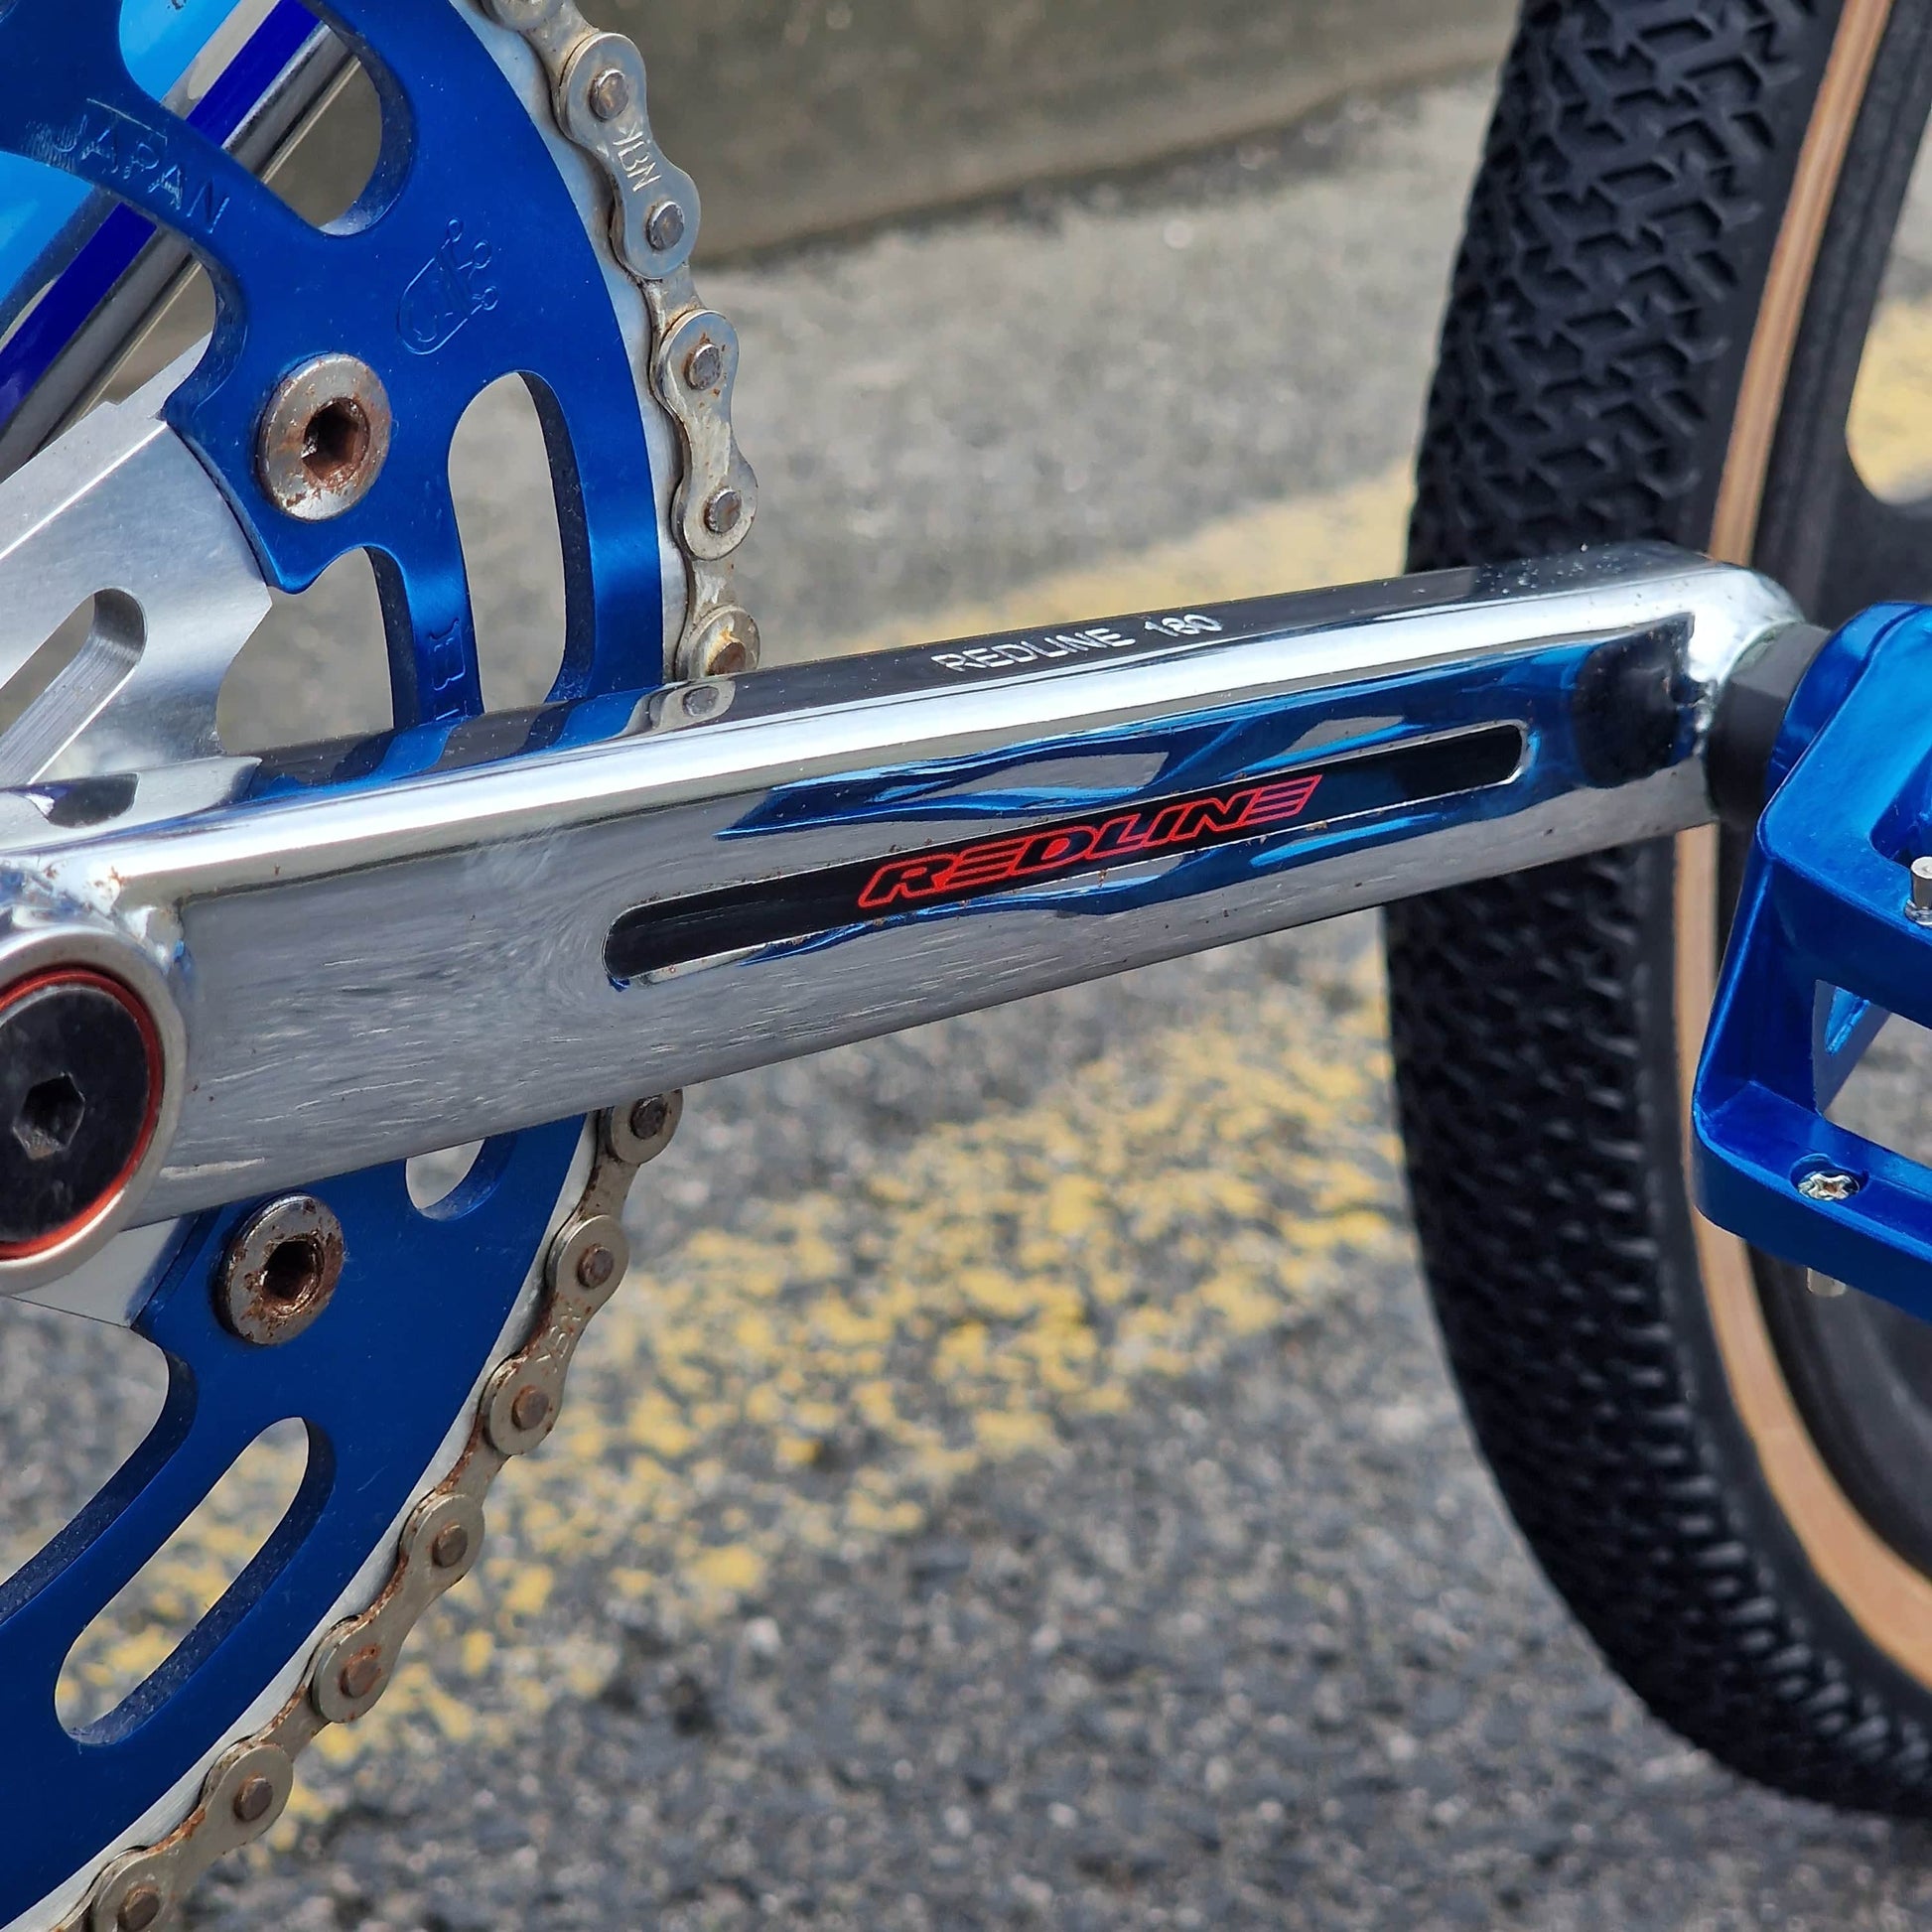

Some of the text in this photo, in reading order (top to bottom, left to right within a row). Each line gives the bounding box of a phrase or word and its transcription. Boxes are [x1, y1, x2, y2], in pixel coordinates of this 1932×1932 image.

[52, 113, 231, 234] JAPAN
[930, 613, 1224, 672] REDLINE 180
[858, 773, 1323, 908] REDLINE
